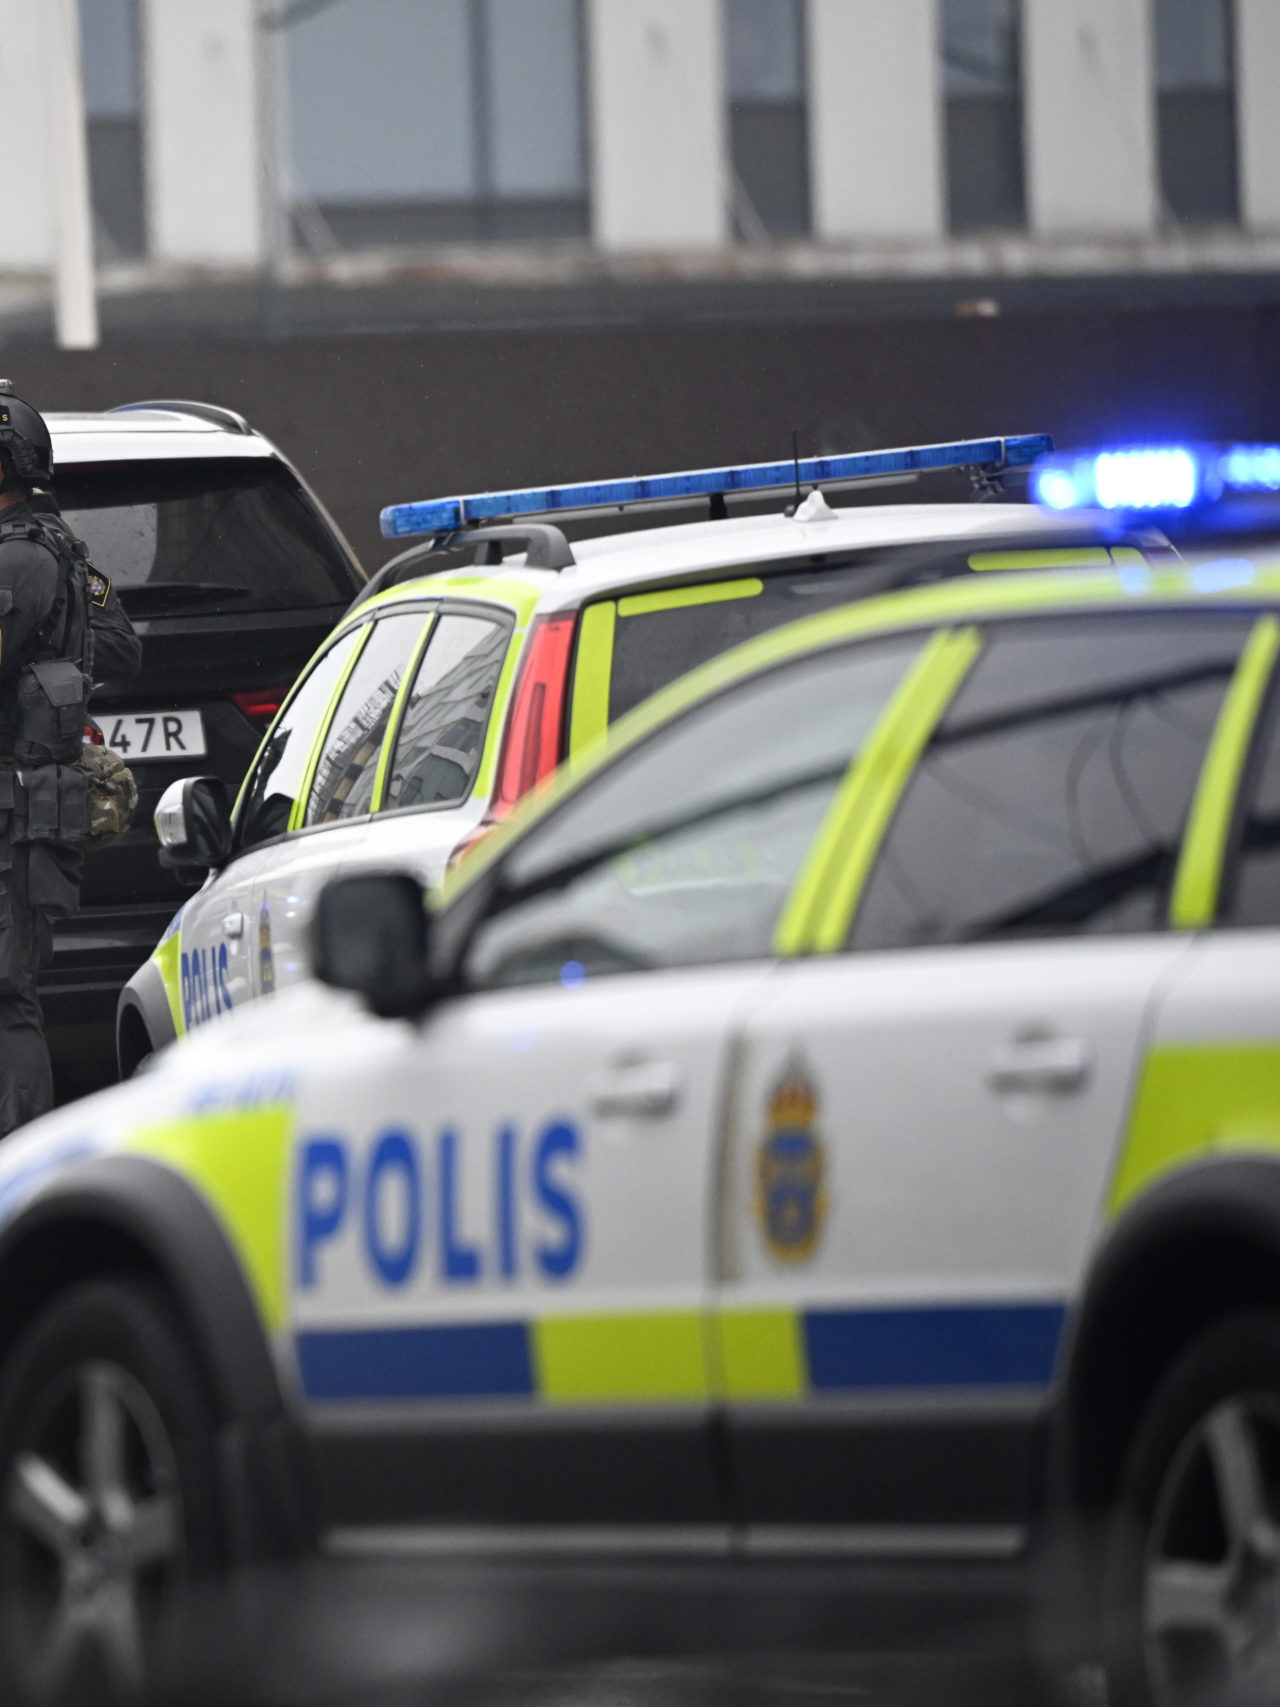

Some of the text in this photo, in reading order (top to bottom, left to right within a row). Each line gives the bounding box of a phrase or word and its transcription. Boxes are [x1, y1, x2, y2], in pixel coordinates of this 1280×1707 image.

[108, 715, 188, 754] 47R
[180, 942, 234, 1032] POLIS
[296, 1112, 588, 1292] POLIS
